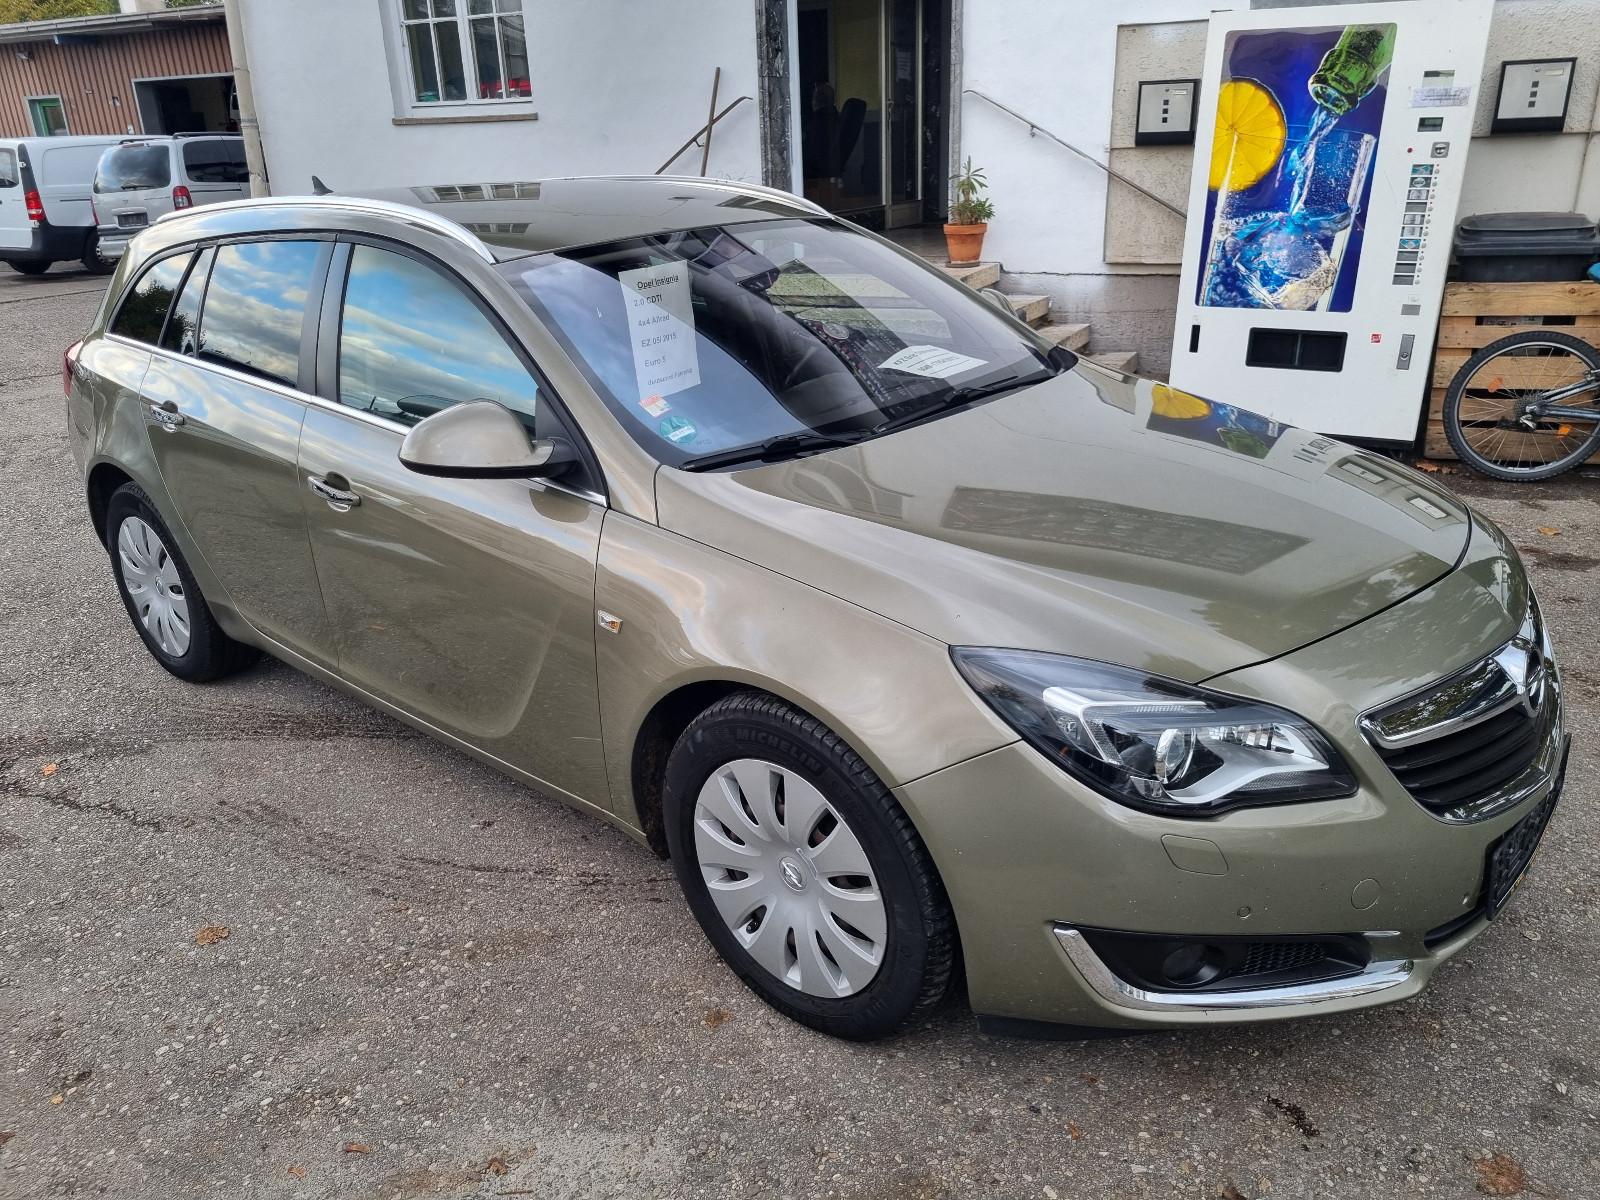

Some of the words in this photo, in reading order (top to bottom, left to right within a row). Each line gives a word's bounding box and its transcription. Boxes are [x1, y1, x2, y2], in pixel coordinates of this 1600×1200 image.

[637, 278, 654, 290] Opel
[654, 274, 679, 287] Insignia
[641, 339, 651, 348] EZ
[736, 728, 822, 773] MICHELIN
